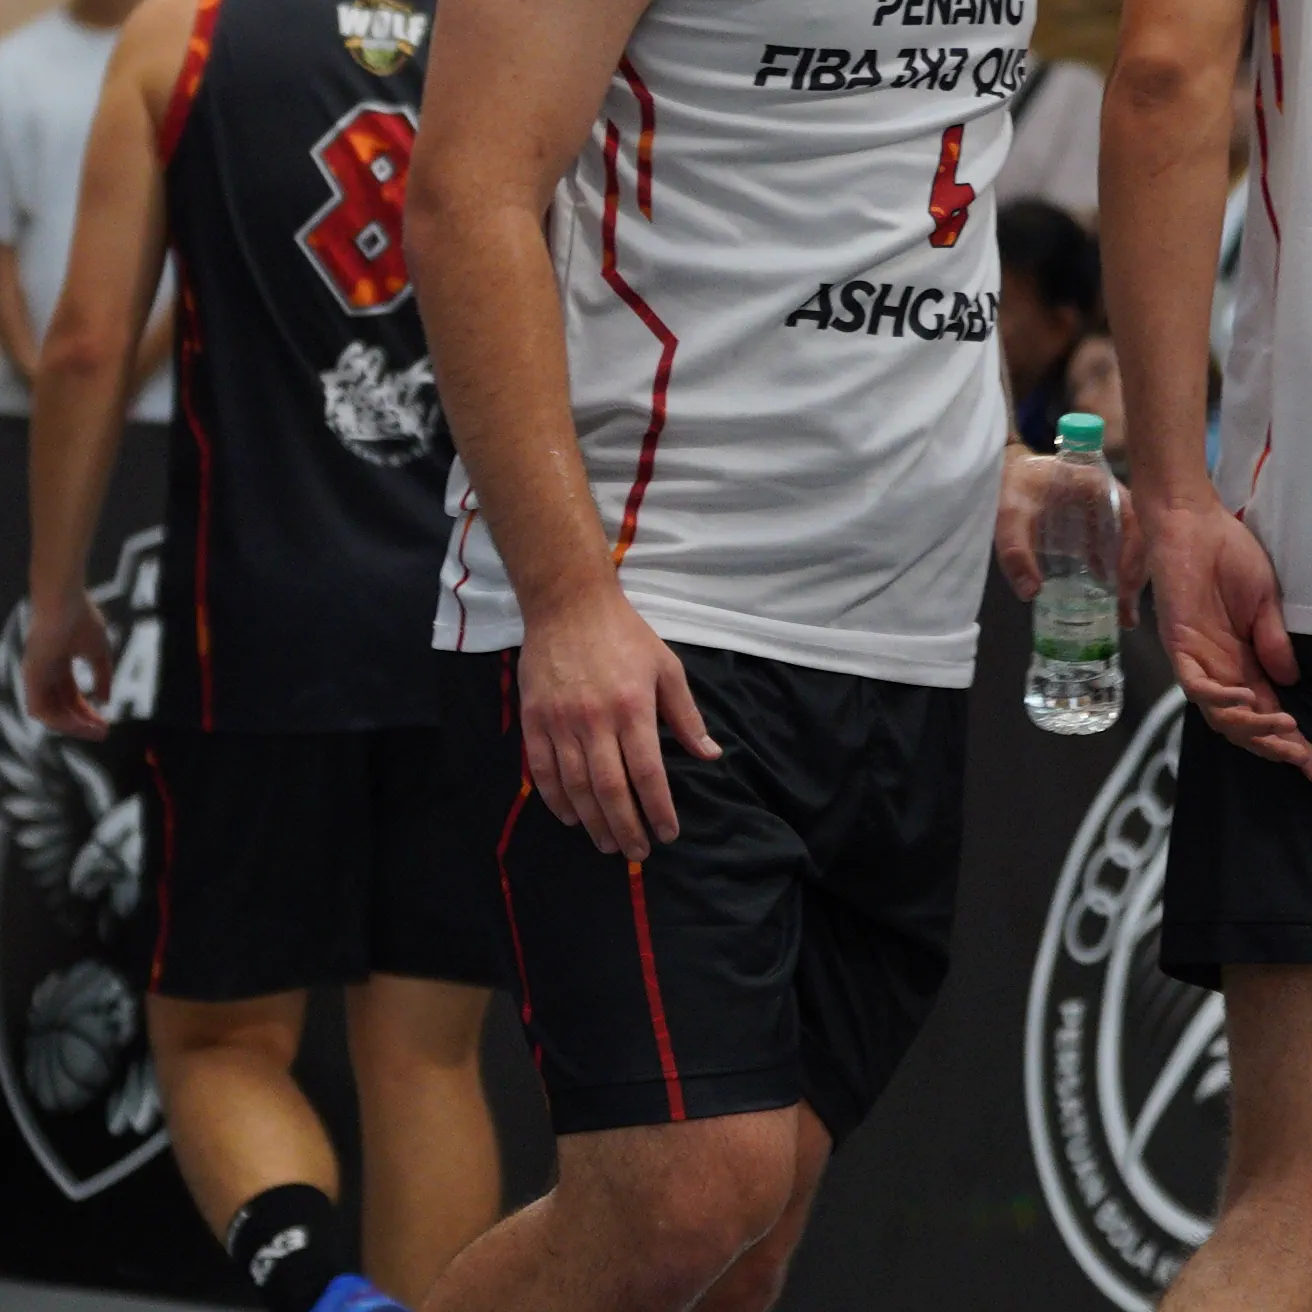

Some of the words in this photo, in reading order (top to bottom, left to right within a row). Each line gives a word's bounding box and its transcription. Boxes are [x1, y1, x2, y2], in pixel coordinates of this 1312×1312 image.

[754, 44, 883, 91] FIBA
[891, 47, 969, 92] 3X3
[295, 100, 421, 317] 8
